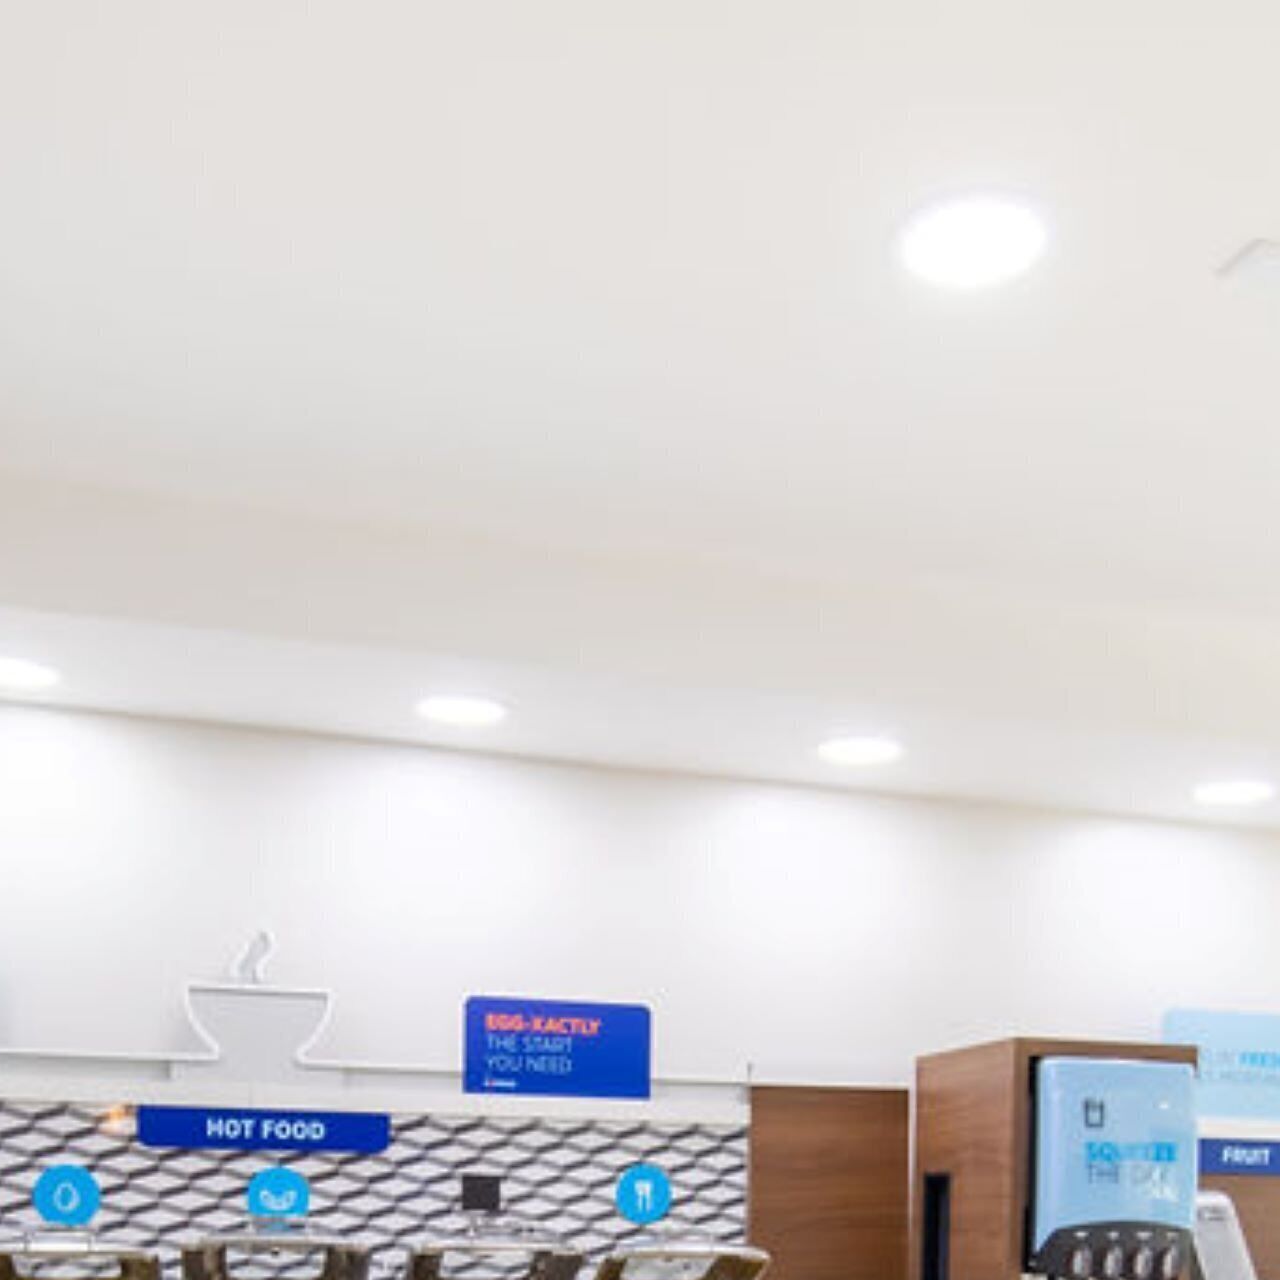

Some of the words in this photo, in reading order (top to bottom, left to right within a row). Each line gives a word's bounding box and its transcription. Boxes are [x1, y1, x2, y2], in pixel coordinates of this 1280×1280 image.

[486, 1033, 517, 1053] THE
[521, 1035, 572, 1054] START
[486, 1054, 523, 1074] YOU
[525, 1055, 573, 1076] NEED
[205, 1117, 255, 1140] HOT
[260, 1119, 327, 1141] FOOD
[1222, 1146, 1271, 1167] FRUIT
